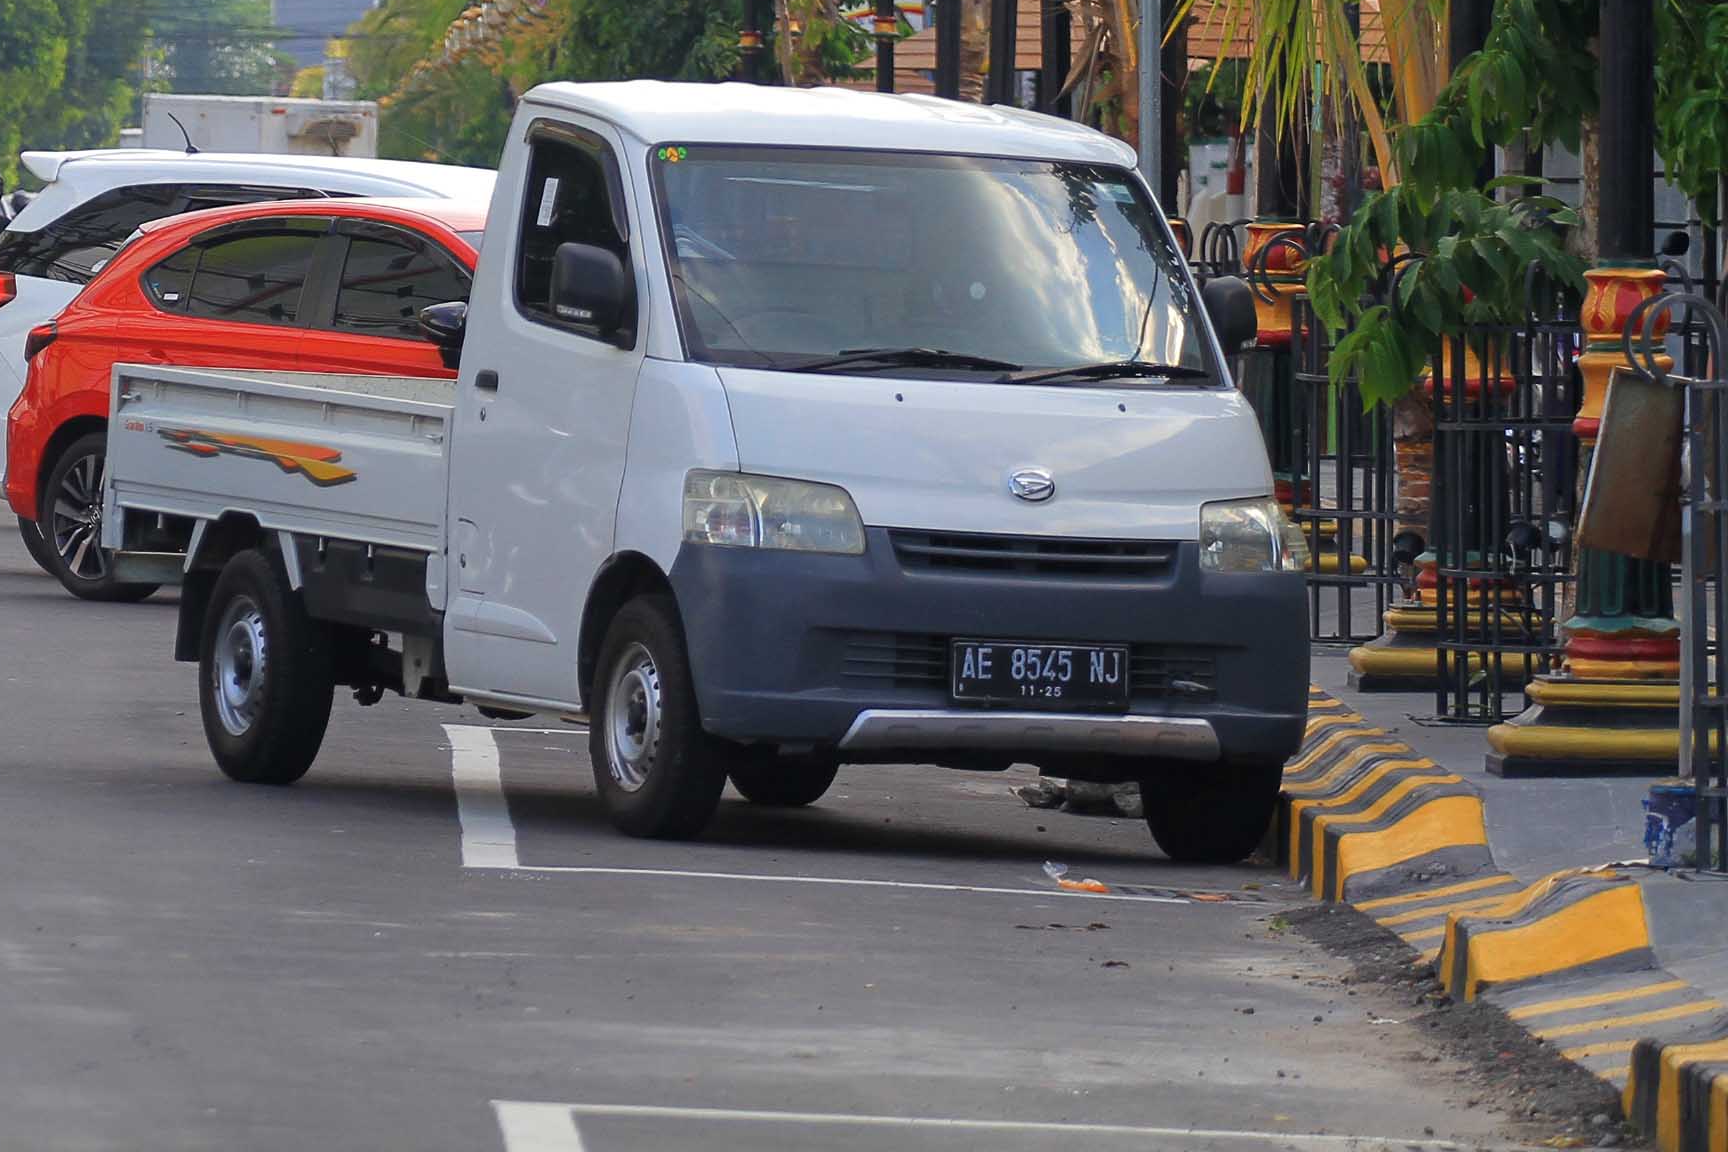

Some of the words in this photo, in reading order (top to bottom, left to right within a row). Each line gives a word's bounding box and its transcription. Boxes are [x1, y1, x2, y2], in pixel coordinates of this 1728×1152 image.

[961, 647, 993, 680] AE
[1011, 648, 1073, 682] 8545
[1089, 651, 1120, 684] NJ
